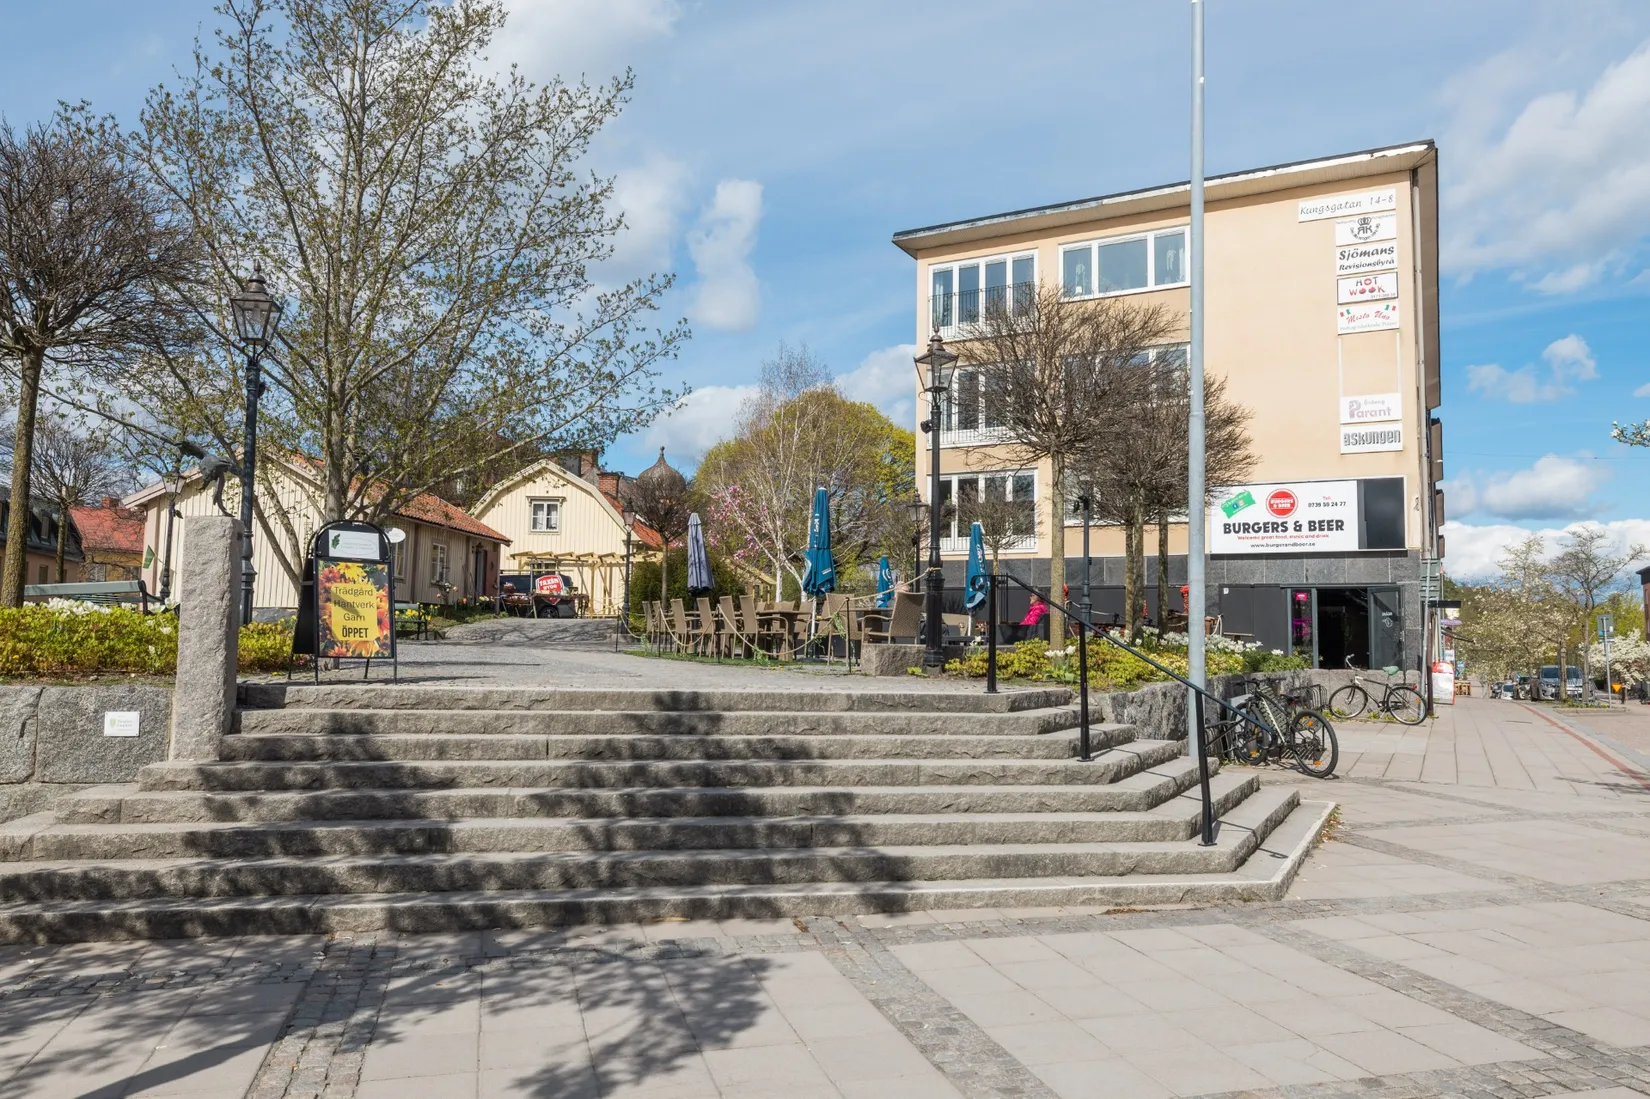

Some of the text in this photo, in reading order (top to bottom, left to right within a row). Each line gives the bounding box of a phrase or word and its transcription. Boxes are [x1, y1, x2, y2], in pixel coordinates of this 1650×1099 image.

[1300, 194, 1394, 215] Kungsgatan 14-8
[1339, 246, 1395, 261] Sjömans
[1339, 258, 1395, 271] Revisionsbyrå
[1356, 276, 1378, 287] HOT
[1343, 429, 1401, 447] askungen
[1223, 519, 1345, 534] BURGERS & BEER
[334, 586, 374, 597] Trädgård
[334, 599, 375, 609] Hantverk
[342, 624, 369, 639] ÖPPET
